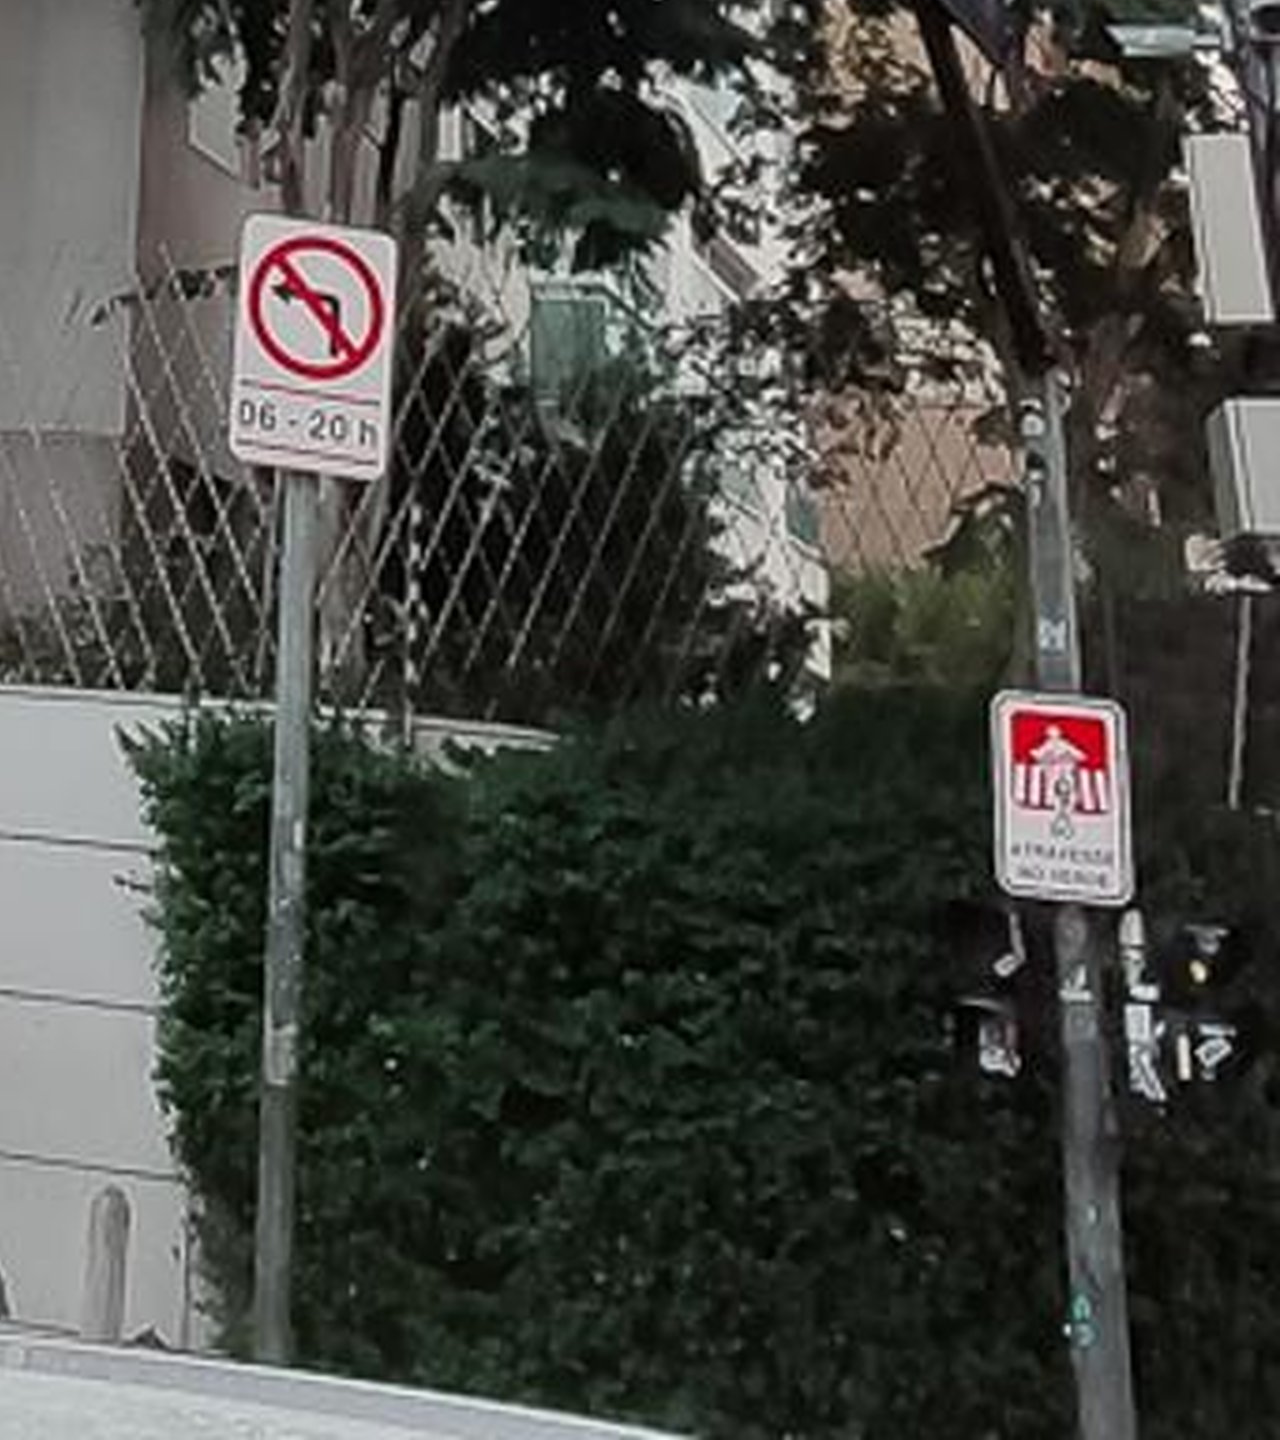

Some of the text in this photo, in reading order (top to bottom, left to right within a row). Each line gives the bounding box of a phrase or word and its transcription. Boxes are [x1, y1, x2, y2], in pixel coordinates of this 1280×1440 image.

[240, 400, 276, 430] 06
[309, 409, 348, 441] 20
[359, 419, 379, 448] h
